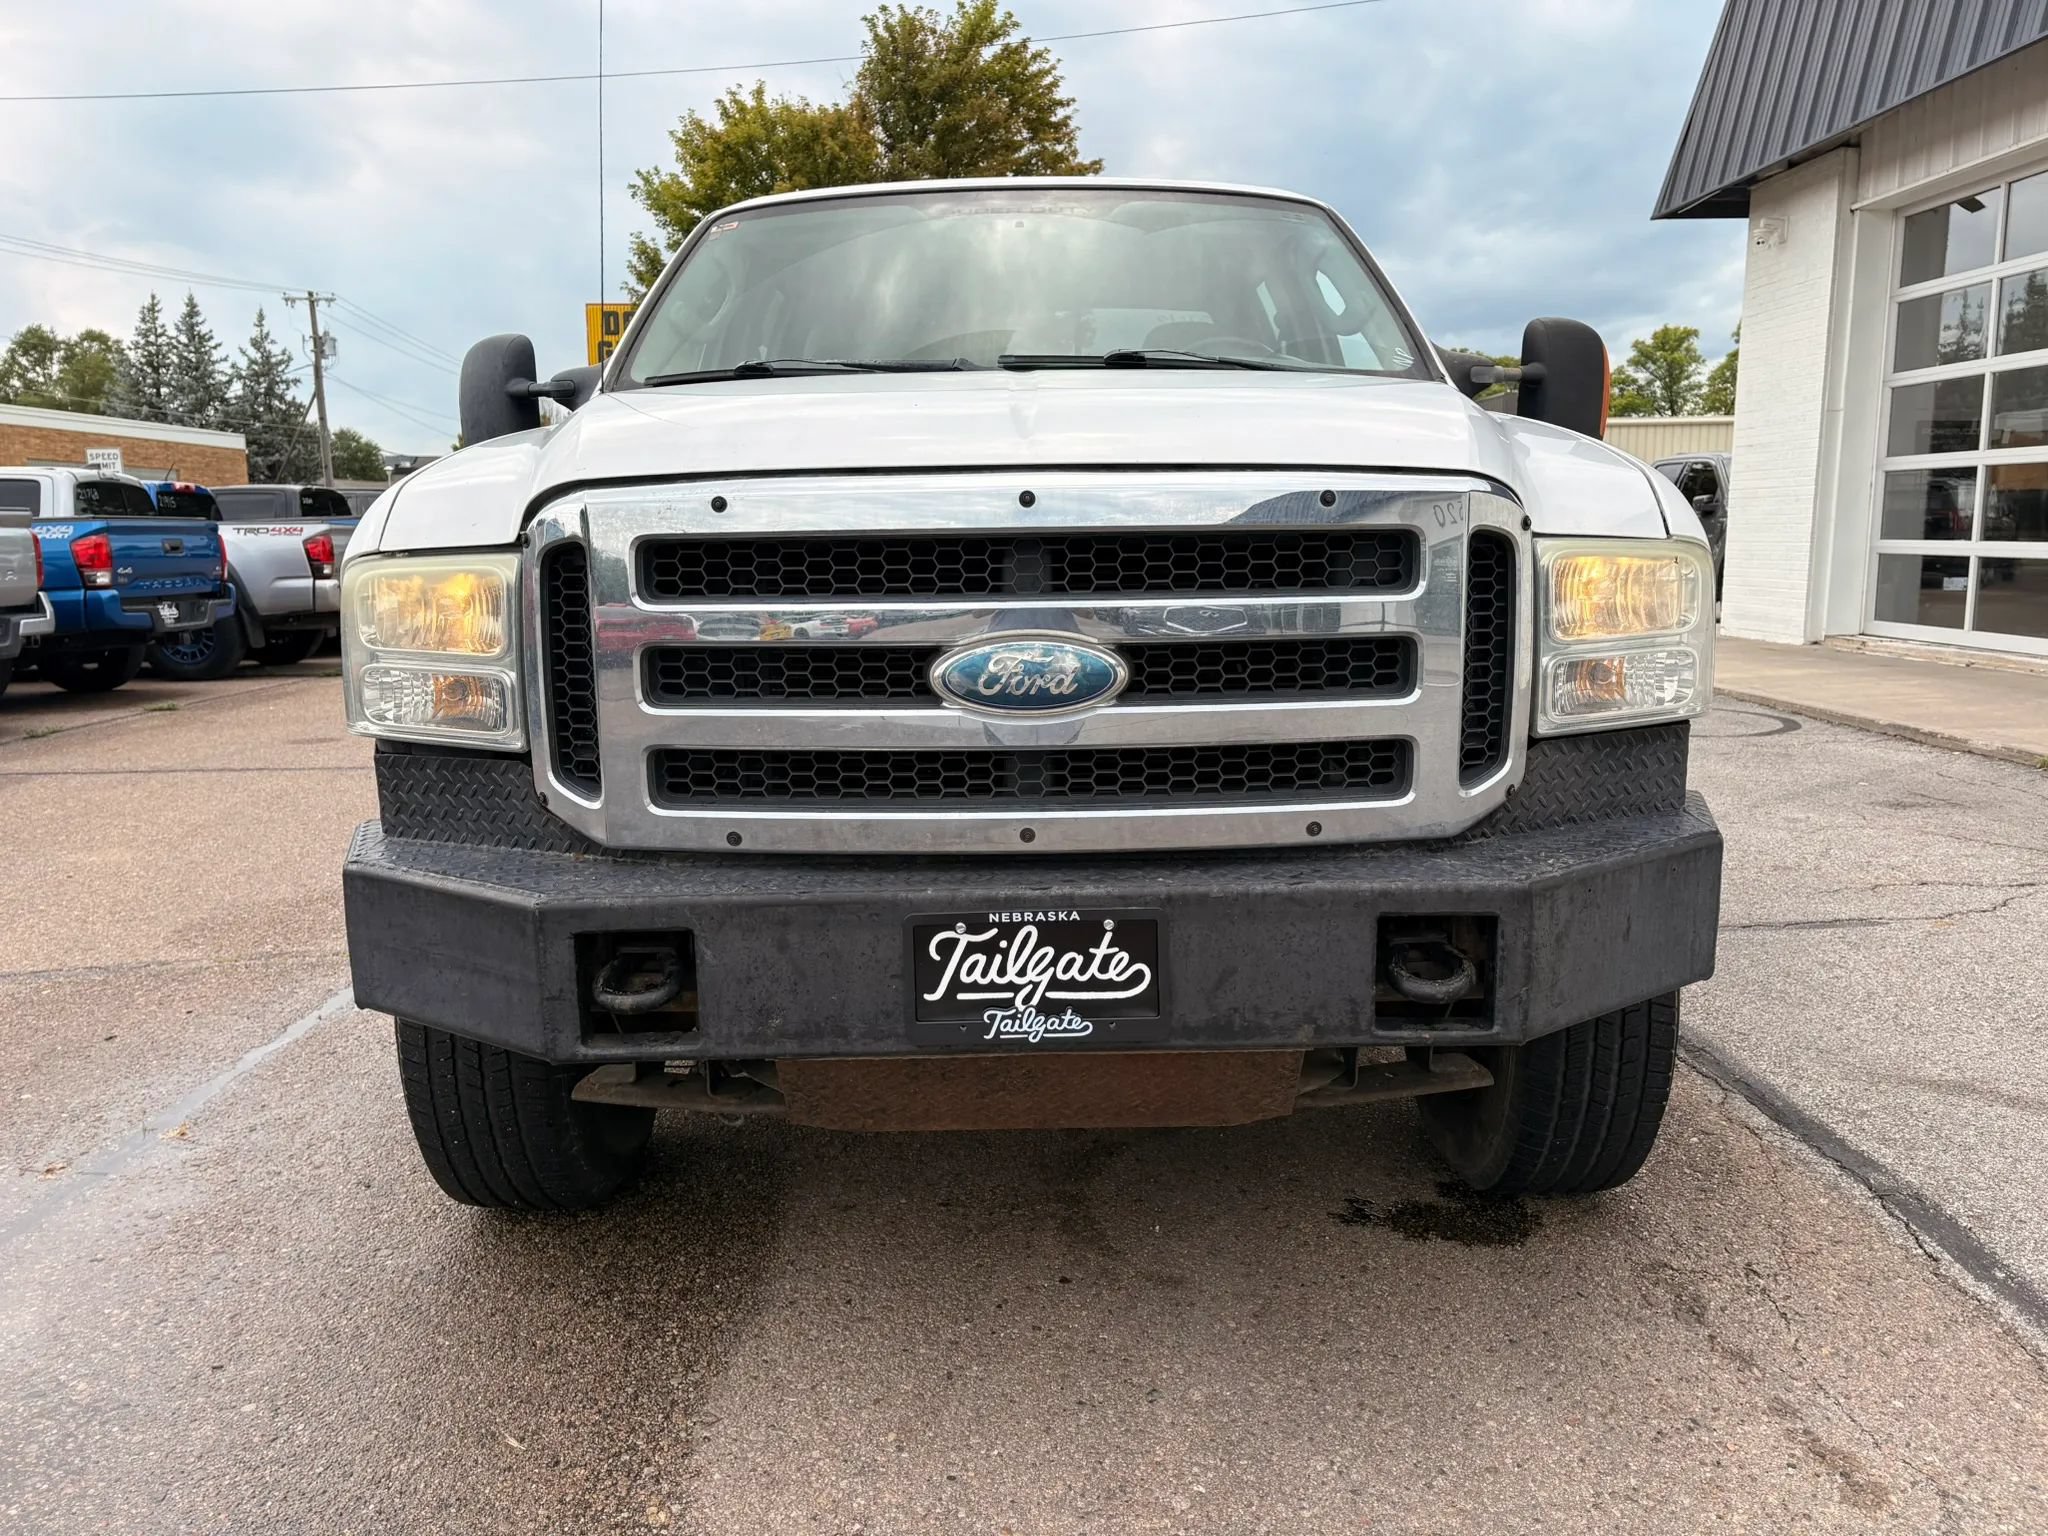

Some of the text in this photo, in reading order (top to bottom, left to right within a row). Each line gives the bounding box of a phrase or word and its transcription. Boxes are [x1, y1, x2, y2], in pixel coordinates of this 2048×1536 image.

[89, 452, 119, 461] SPEED
[232, 527, 270, 536] TRD
[977, 653, 1079, 696] Ford
[988, 910, 1081, 923] NEBRASKA
[923, 924, 1152, 1010] Tailgate
[983, 1006, 1094, 1043] Tailgate
